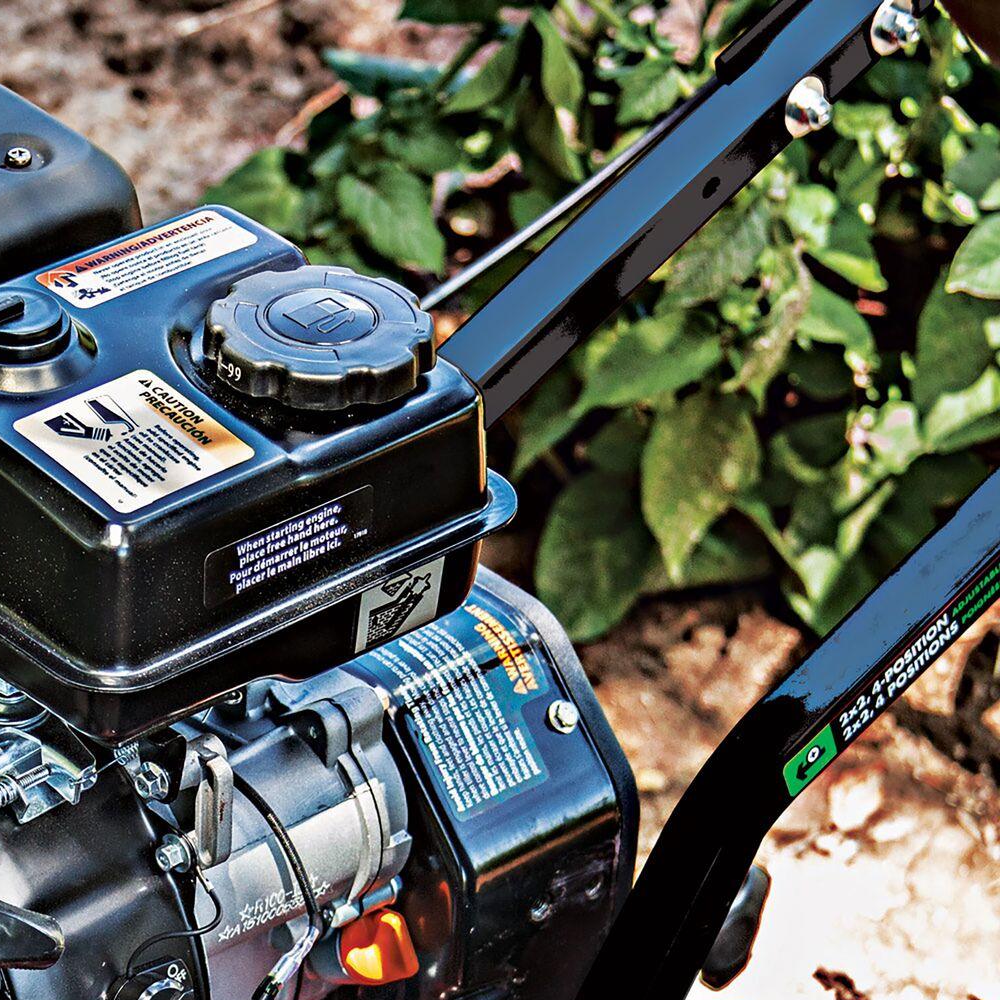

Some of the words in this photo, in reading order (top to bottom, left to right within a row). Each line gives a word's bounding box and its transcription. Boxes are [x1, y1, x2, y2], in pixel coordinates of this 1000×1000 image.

[83, 215, 214, 268] WARNING/ADVERTENCIA
[137, 390, 215, 445] PRECAUCIÓN
[149, 385, 204, 424] CAUTION
[230, 567, 252, 583] Pour
[254, 546, 298, 572] démarrer
[300, 542, 309, 552] le
[310, 525, 347, 547] moteur,
[237, 538, 264, 556] When
[266, 520, 304, 545] starting
[306, 505, 341, 526] engine,
[240, 549, 265, 568] place
[267, 540, 286, 553] free
[288, 526, 312, 544] hand
[314, 518, 338, 533] here.
[236, 572, 265, 594] placer
[267, 567, 276, 577] le
[278, 556, 301, 573] main
[303, 546, 325, 561] libre
[464, 604, 538, 690] AVERTISSEMENT
[474, 620, 516, 683] WARNING
[839, 696, 870, 727] 2x2,
[872, 613, 948, 694] 4-POSITION
[953, 563, 1000, 617] ADJUSTABL
[843, 709, 873, 741] 2x2,
[876, 694, 884, 708] 4
[888, 620, 958, 697] POSITIONS
